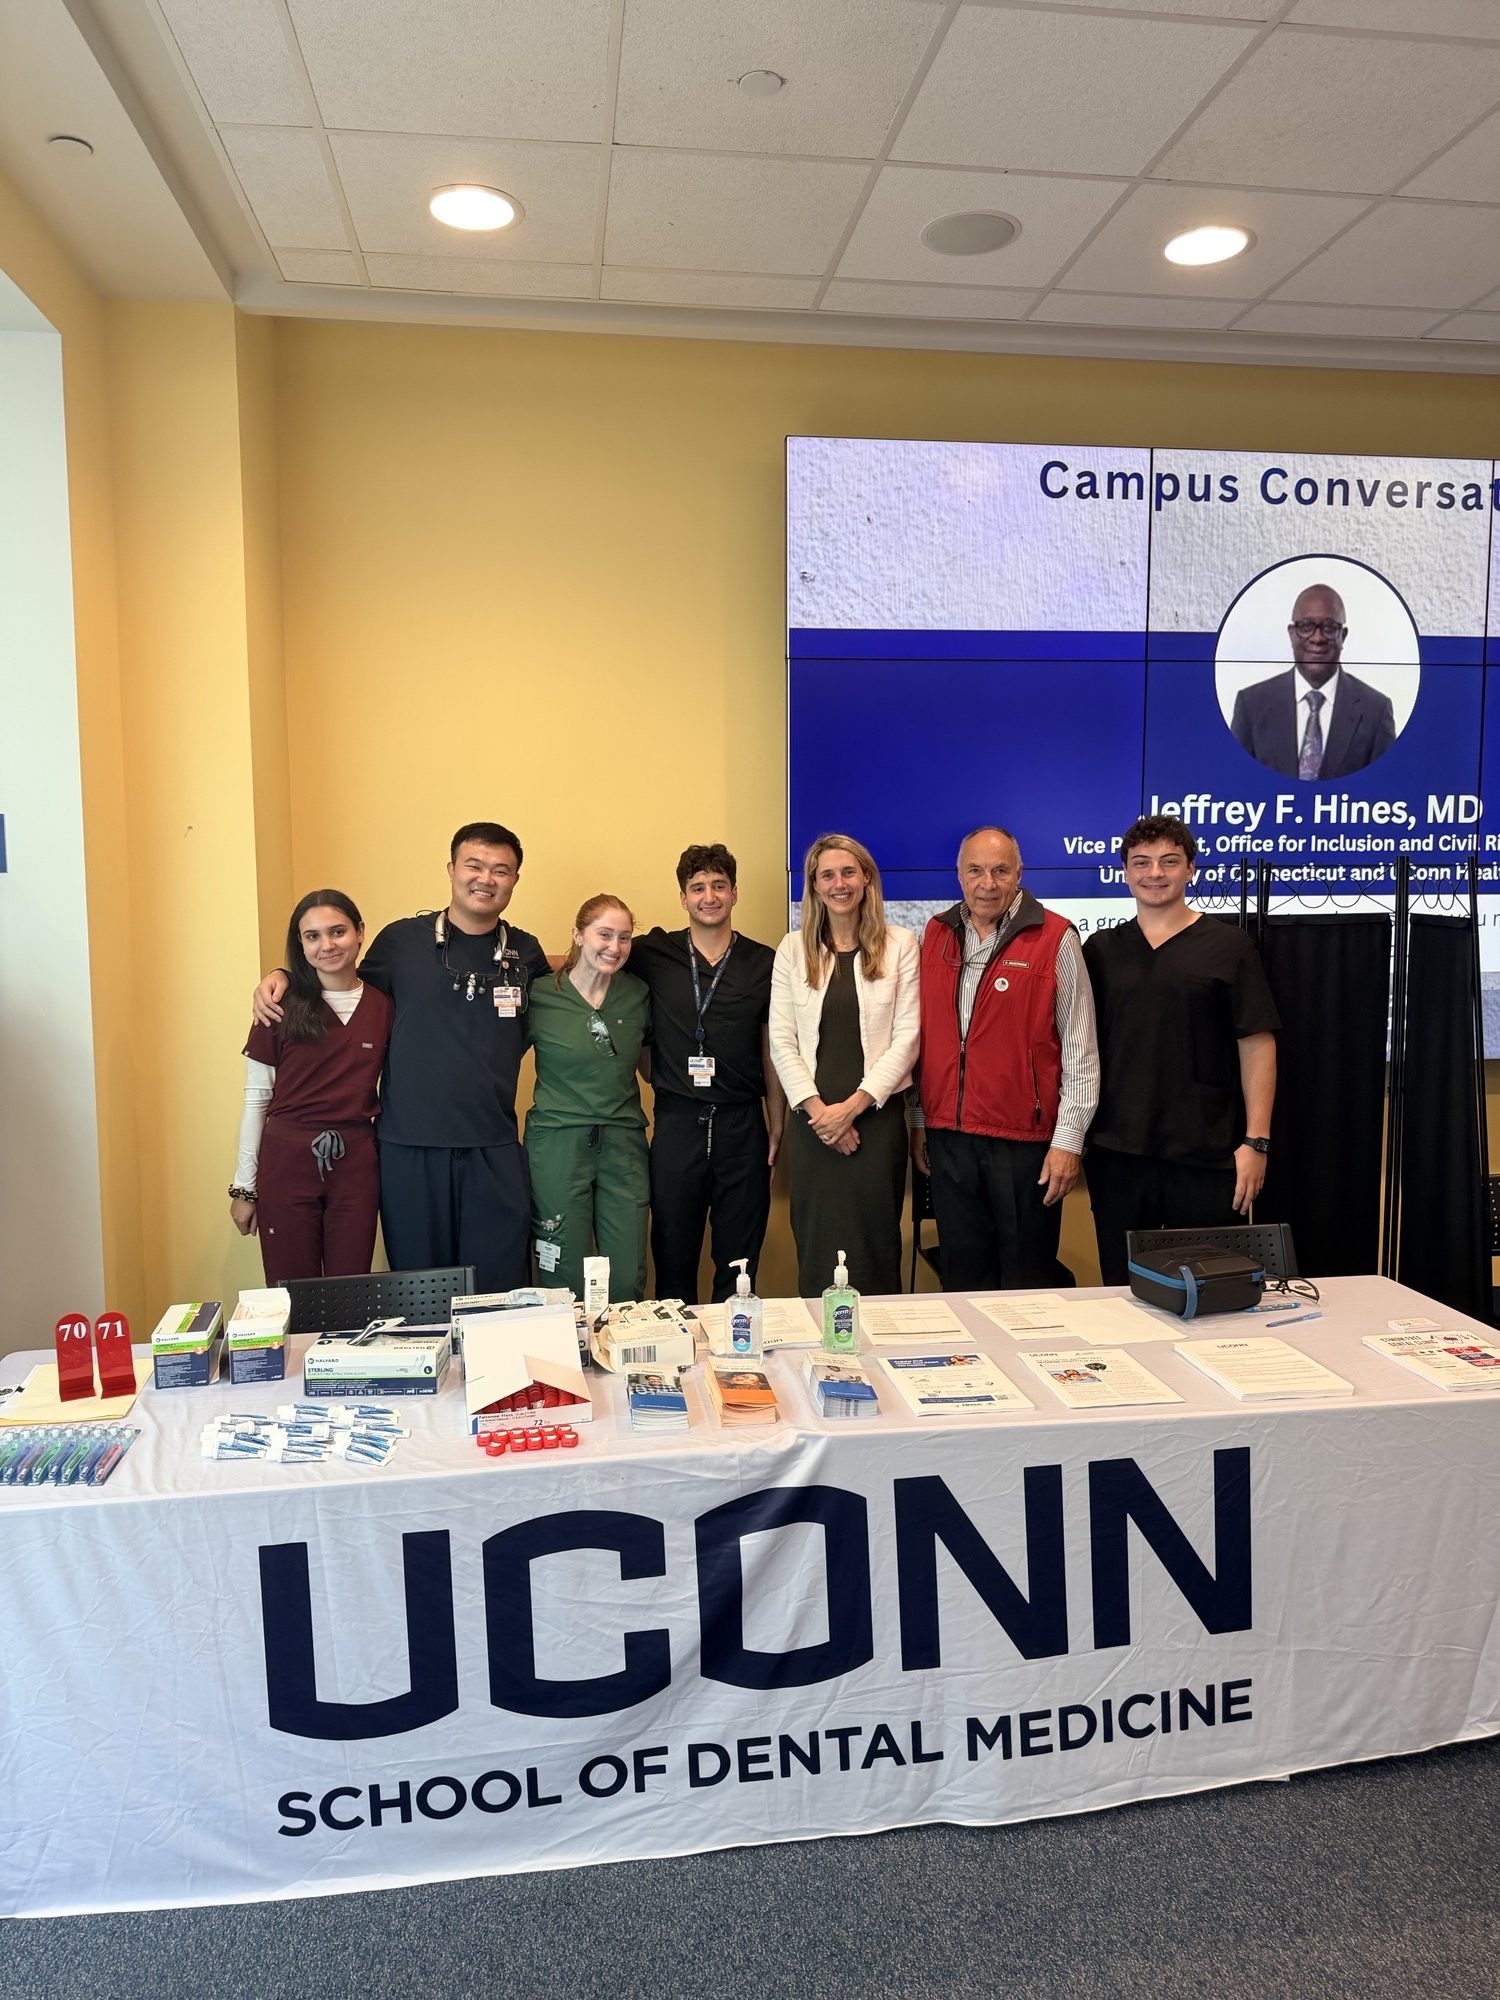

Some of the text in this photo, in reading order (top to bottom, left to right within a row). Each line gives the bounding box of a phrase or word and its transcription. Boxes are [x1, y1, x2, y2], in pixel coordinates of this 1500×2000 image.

[1039, 461, 1239, 511] Campus
[1138, 794, 1483, 832] Jeffrey F. Hines, MD
[1063, 836, 1106, 854] Vice
[1216, 835, 1274, 853] Office
[1278, 835, 1306, 853] for
[1311, 834, 1395, 853] Inclusion
[1399, 834, 1434, 852] and
[1438, 834, 1480, 852] Civil
[1205, 863, 1226, 881] of
[1350, 862, 1385, 881] and
[58, 1322, 87, 1341] 70
[98, 1320, 125, 1340] 71
[259, 1447, 1252, 1740] UCONN
[278, 1678, 1252, 1836] SCHOOL OF DENTAL MEDICINE
